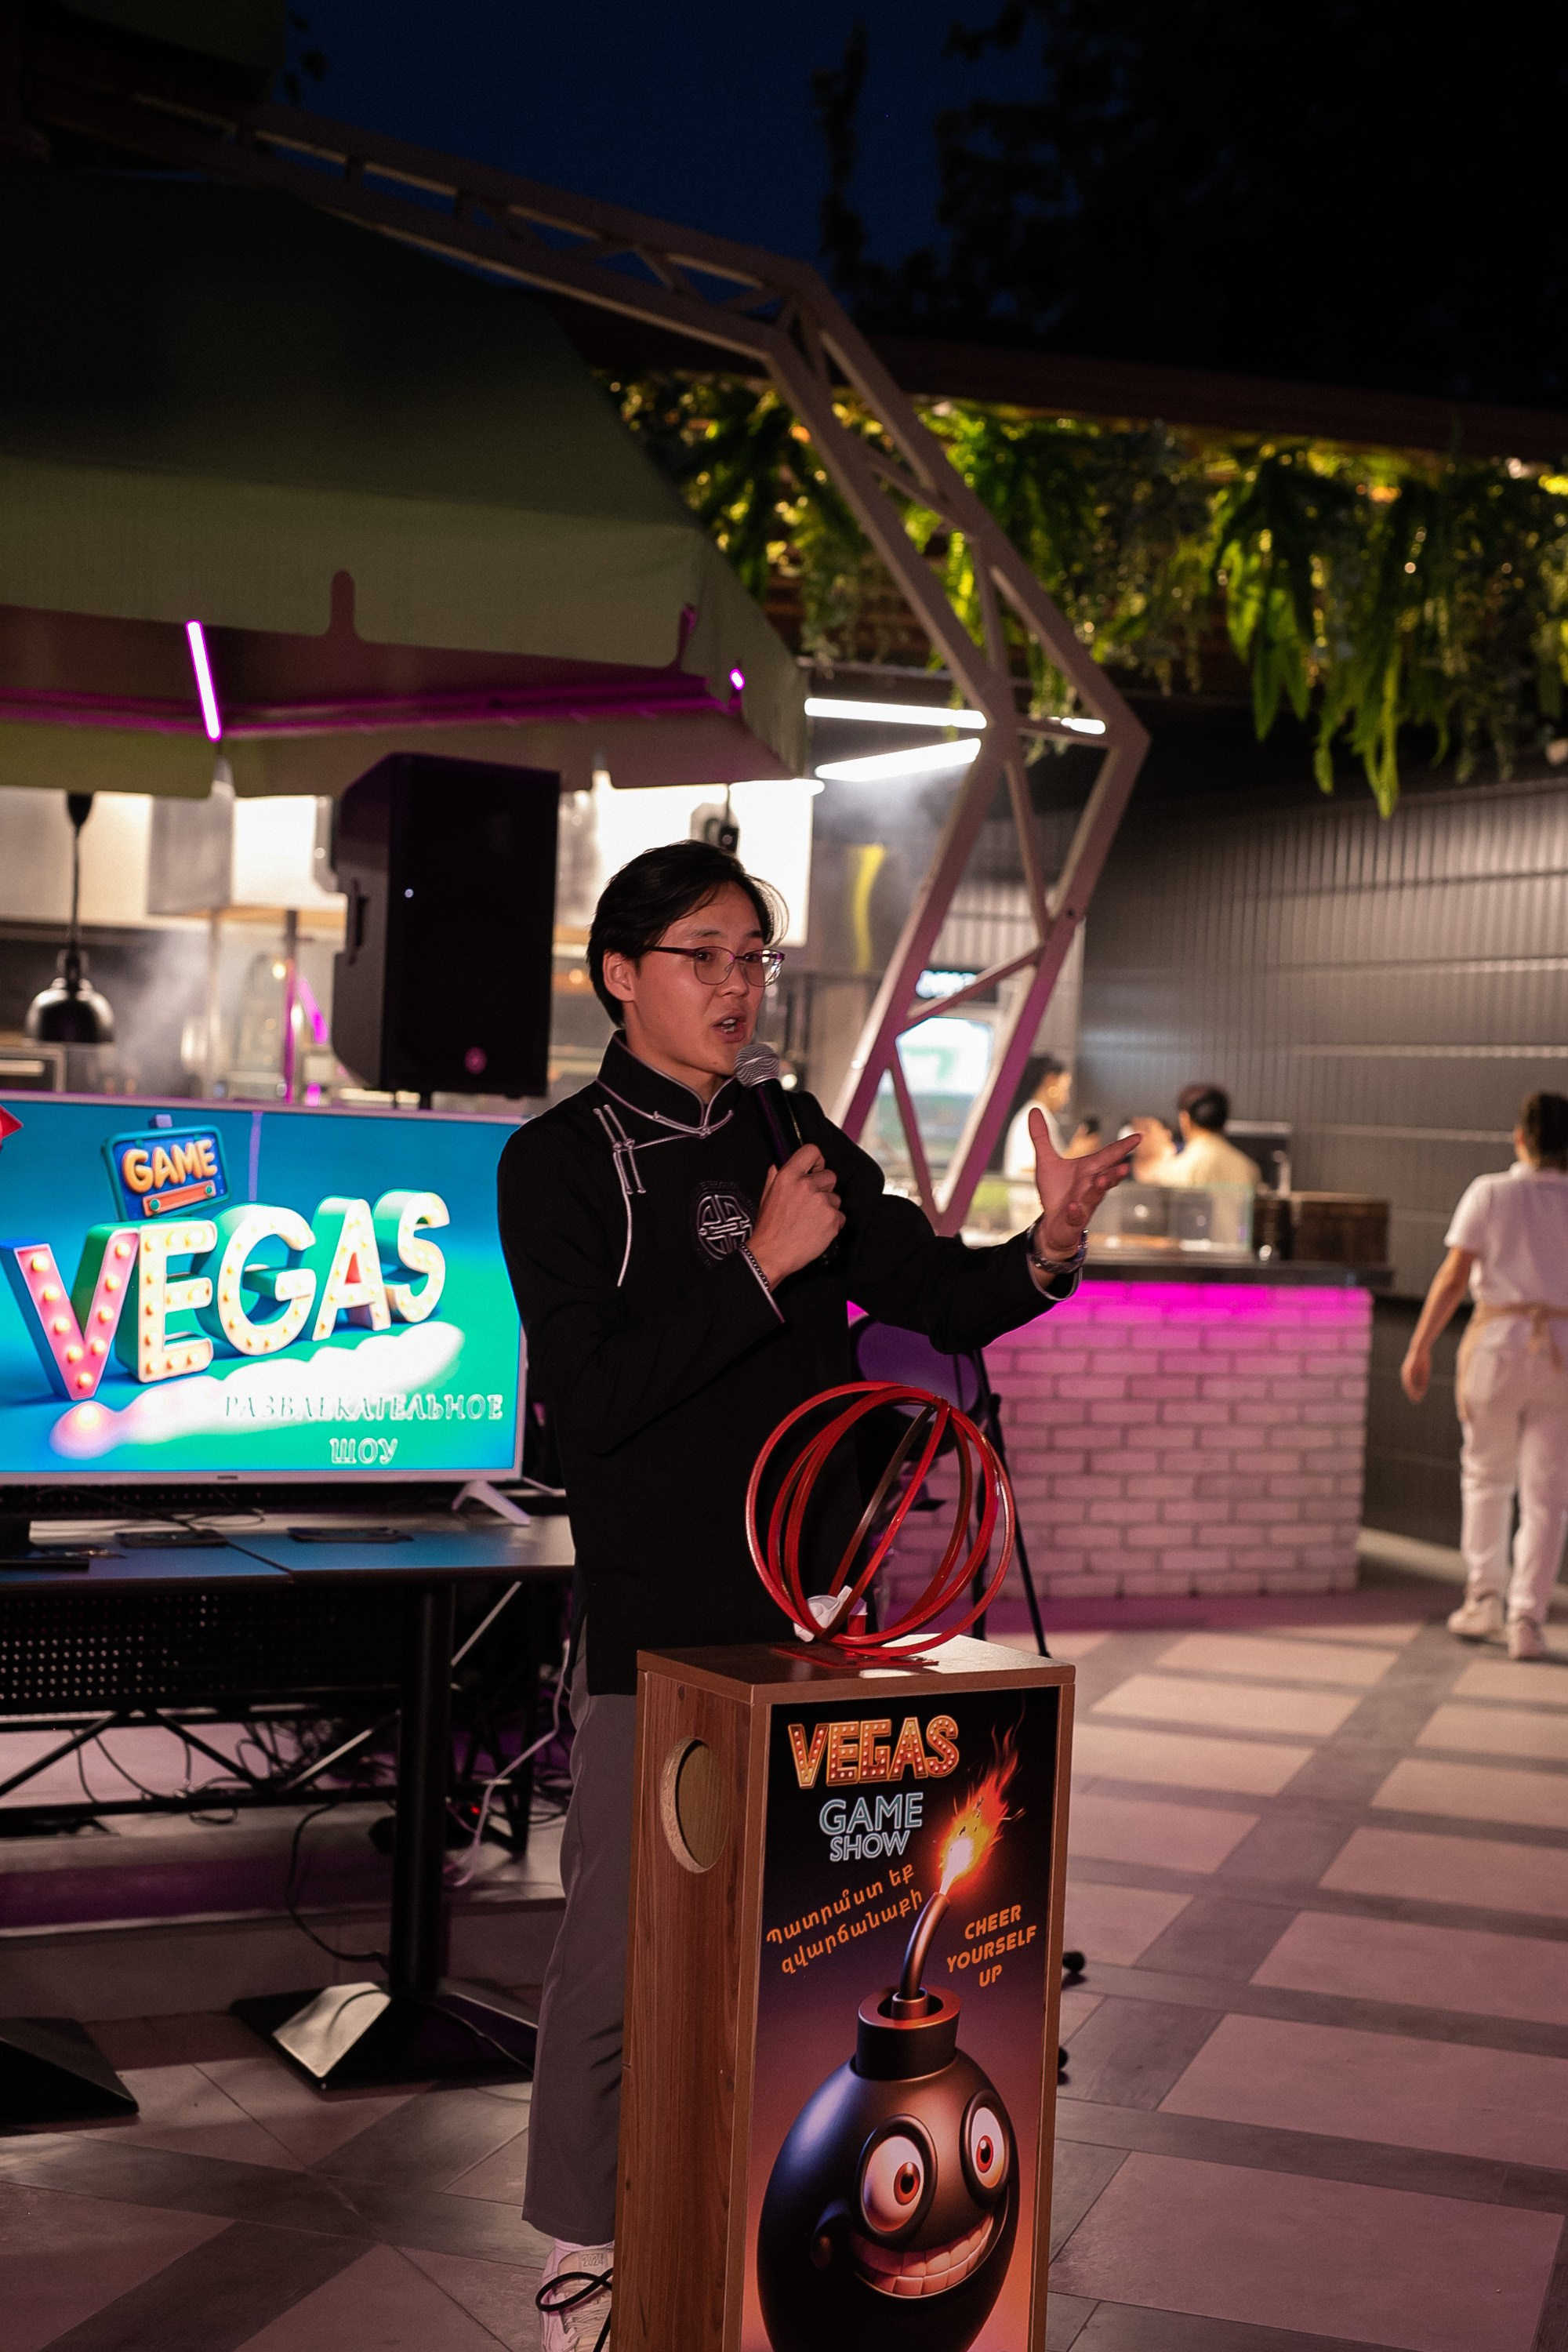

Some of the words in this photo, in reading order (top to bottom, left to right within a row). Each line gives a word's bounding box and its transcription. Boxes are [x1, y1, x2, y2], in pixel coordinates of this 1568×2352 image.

[122, 1138, 219, 1193] GAME
[0, 1190, 450, 1401] VEGAS
[329, 1437, 398, 1465] ШОУ
[787, 1715, 960, 1789] VEGAS
[819, 1792, 924, 1835] GAME
[829, 1830, 910, 1862] SHOW
[964, 1904, 1022, 1940] CHEER
[946, 1925, 1037, 1973] YOURSELF
[978, 1964, 1003, 1987] UP
